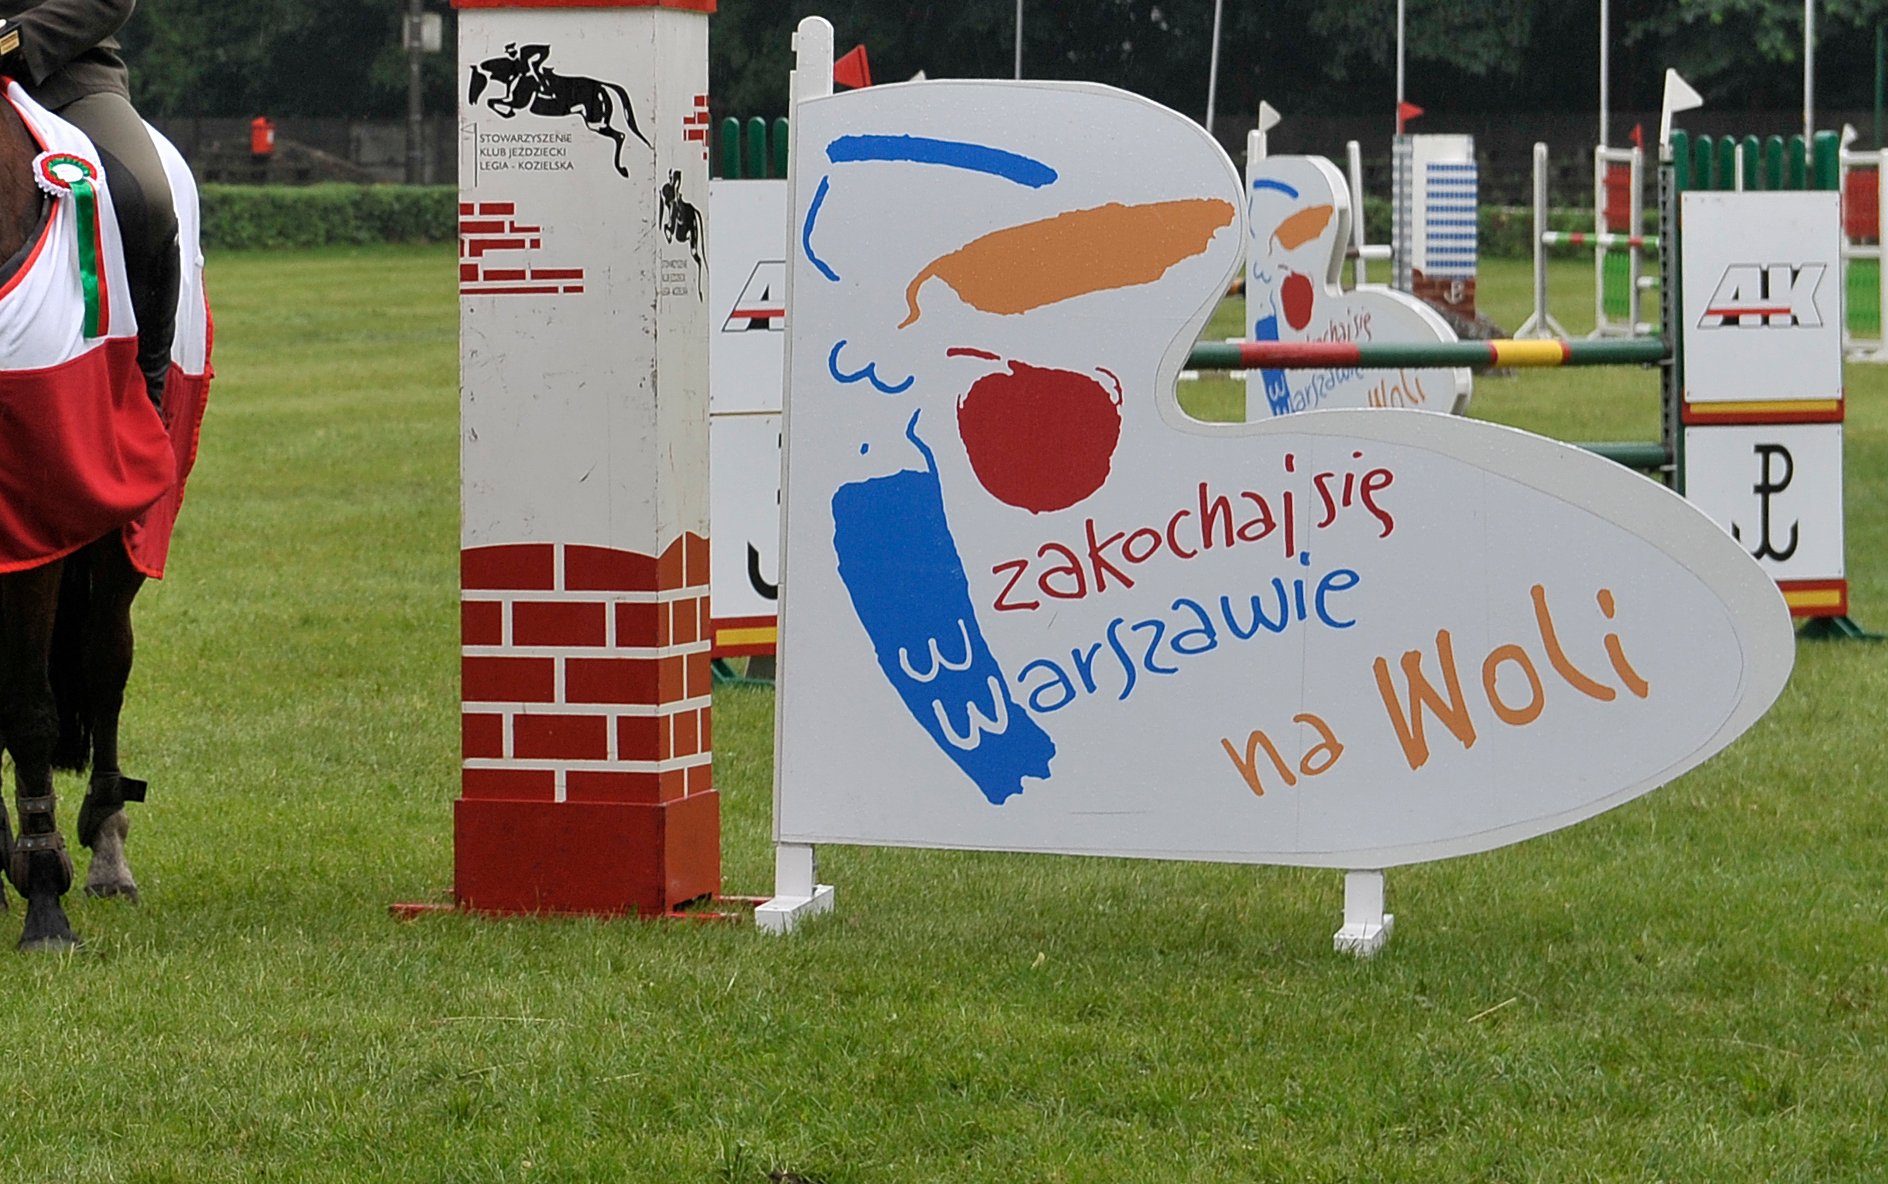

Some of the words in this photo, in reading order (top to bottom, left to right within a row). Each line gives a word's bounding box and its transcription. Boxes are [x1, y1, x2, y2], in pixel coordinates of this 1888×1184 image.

[479, 133, 573, 144] STOWARZYSZENIE
[479, 147, 507, 157] KLUB
[479, 161, 509, 171] LEGIA
[518, 161, 575, 171] KOZIELSKA
[1697, 262, 1827, 329] AK
[991, 453, 1296, 611] zakochaj
[1313, 451, 1394, 538] się
[1220, 713, 1344, 797] na
[1373, 583, 1650, 770] Woli
